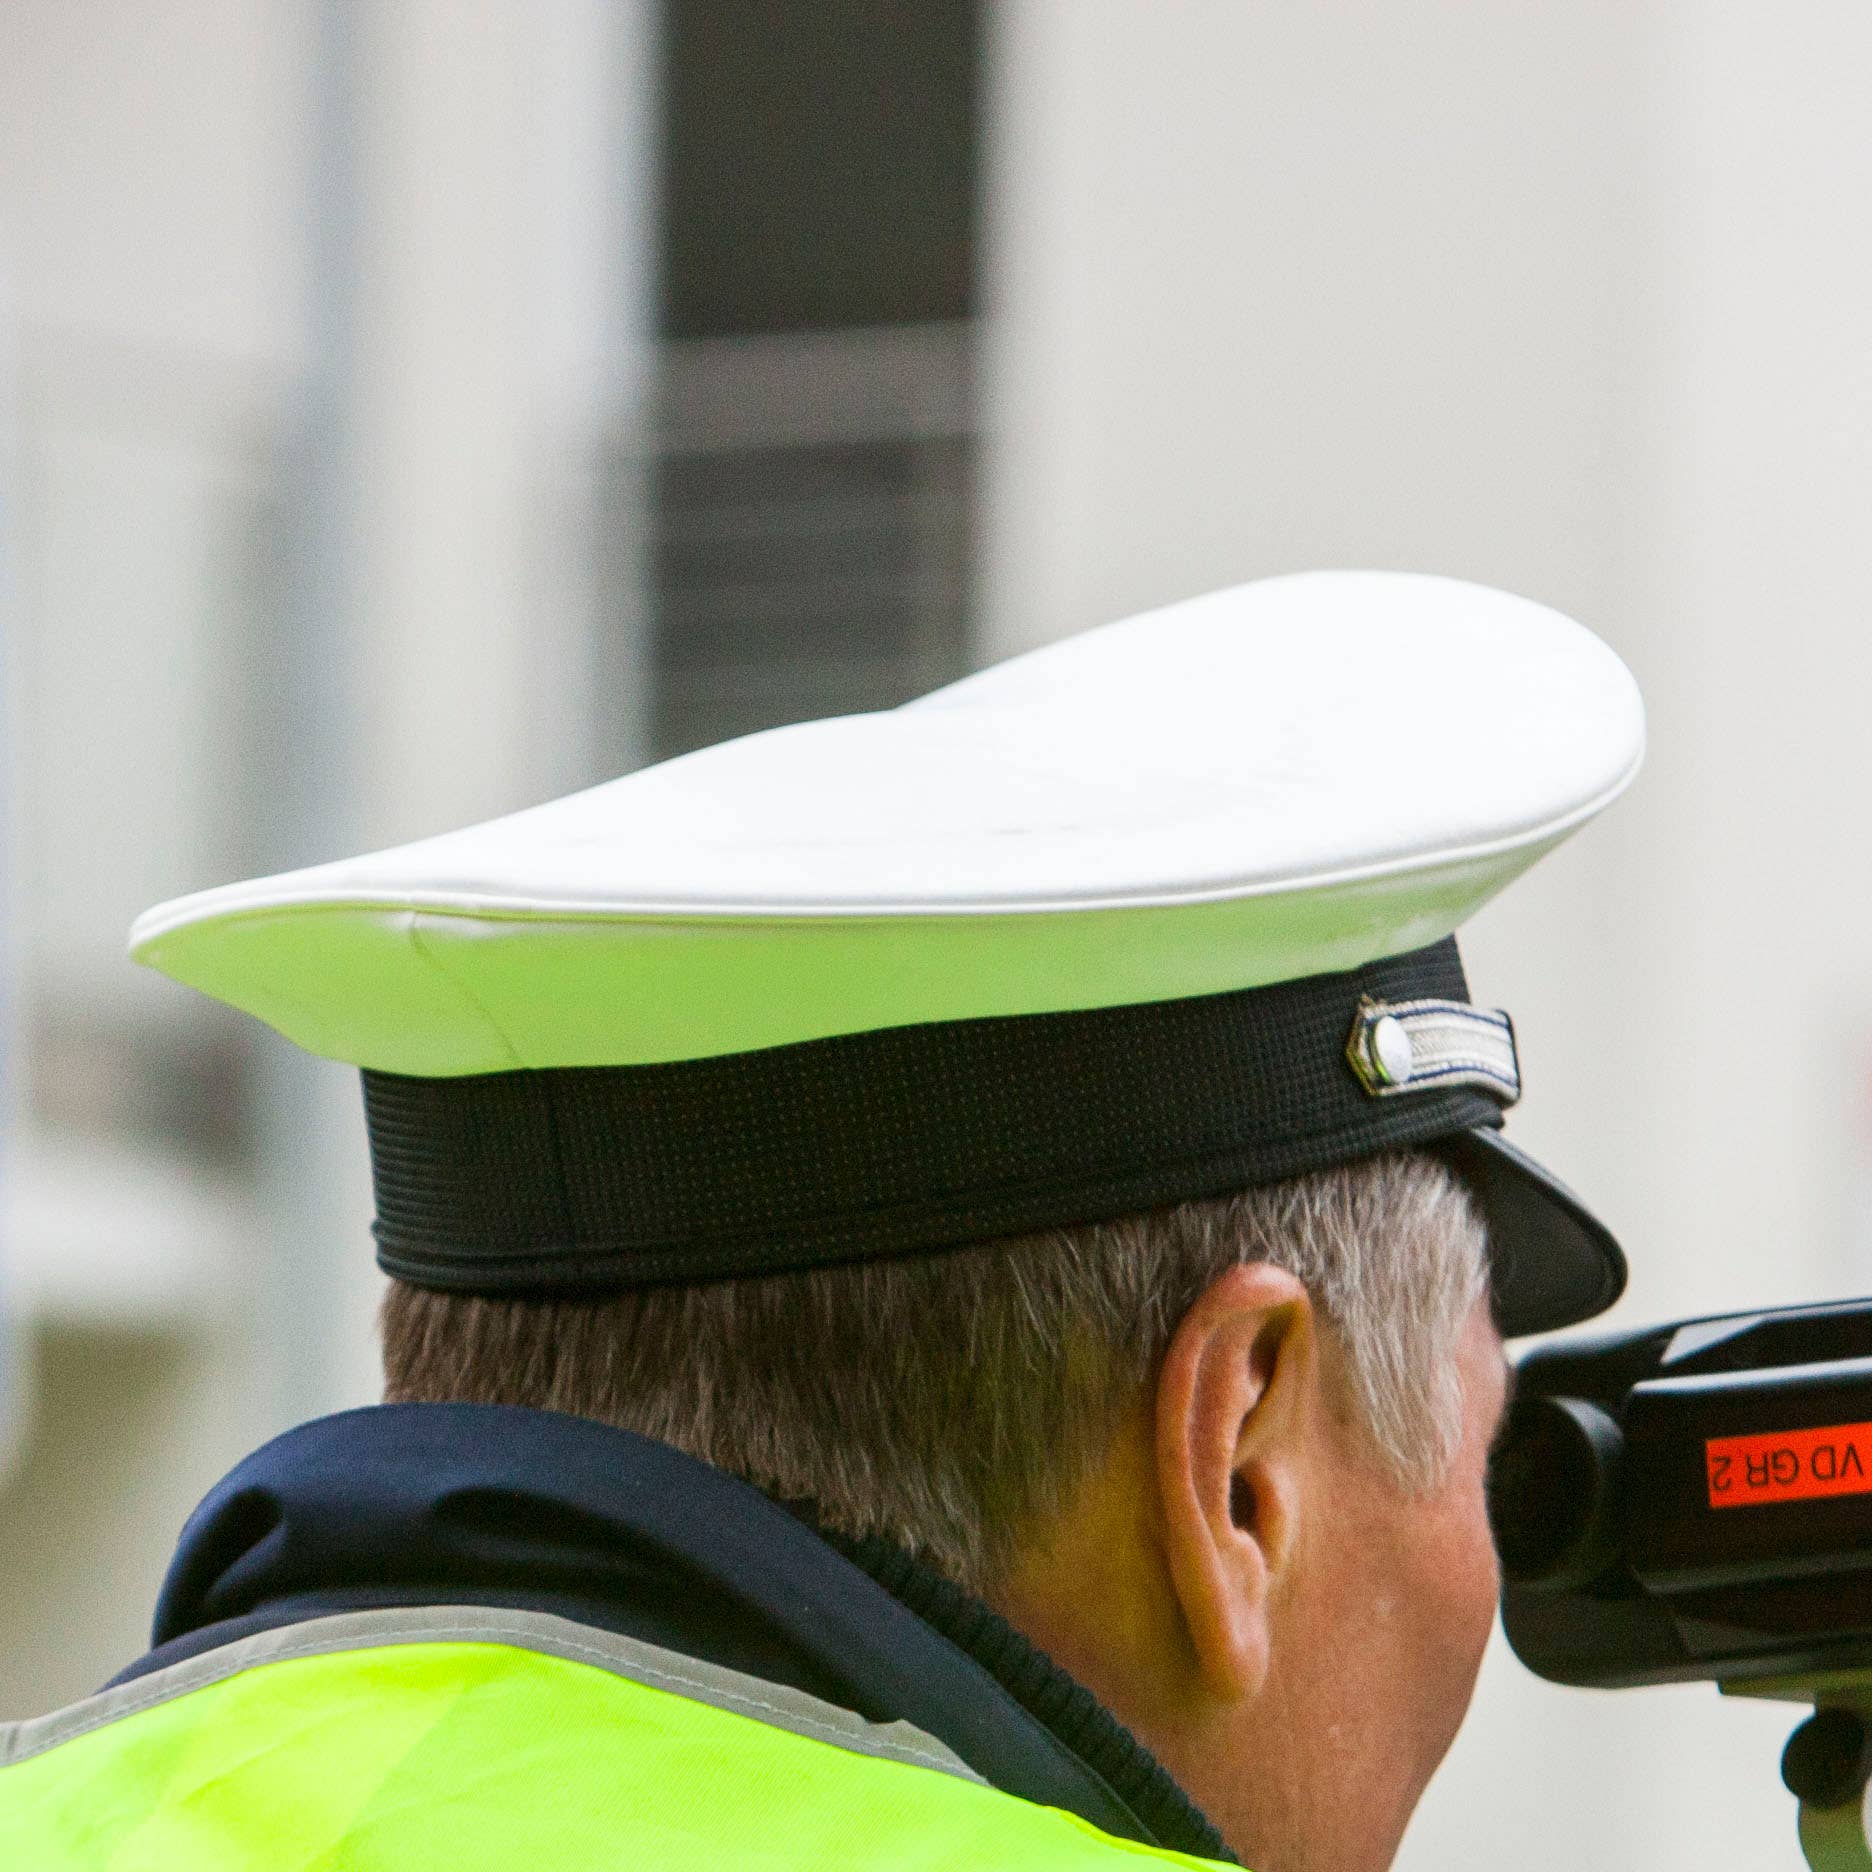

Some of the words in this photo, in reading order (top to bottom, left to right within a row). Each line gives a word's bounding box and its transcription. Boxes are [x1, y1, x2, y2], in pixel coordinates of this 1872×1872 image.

[1712, 1456, 1732, 1491] 2
[1745, 1448, 1800, 1488] GR
[1810, 1443, 1865, 1481] VD
